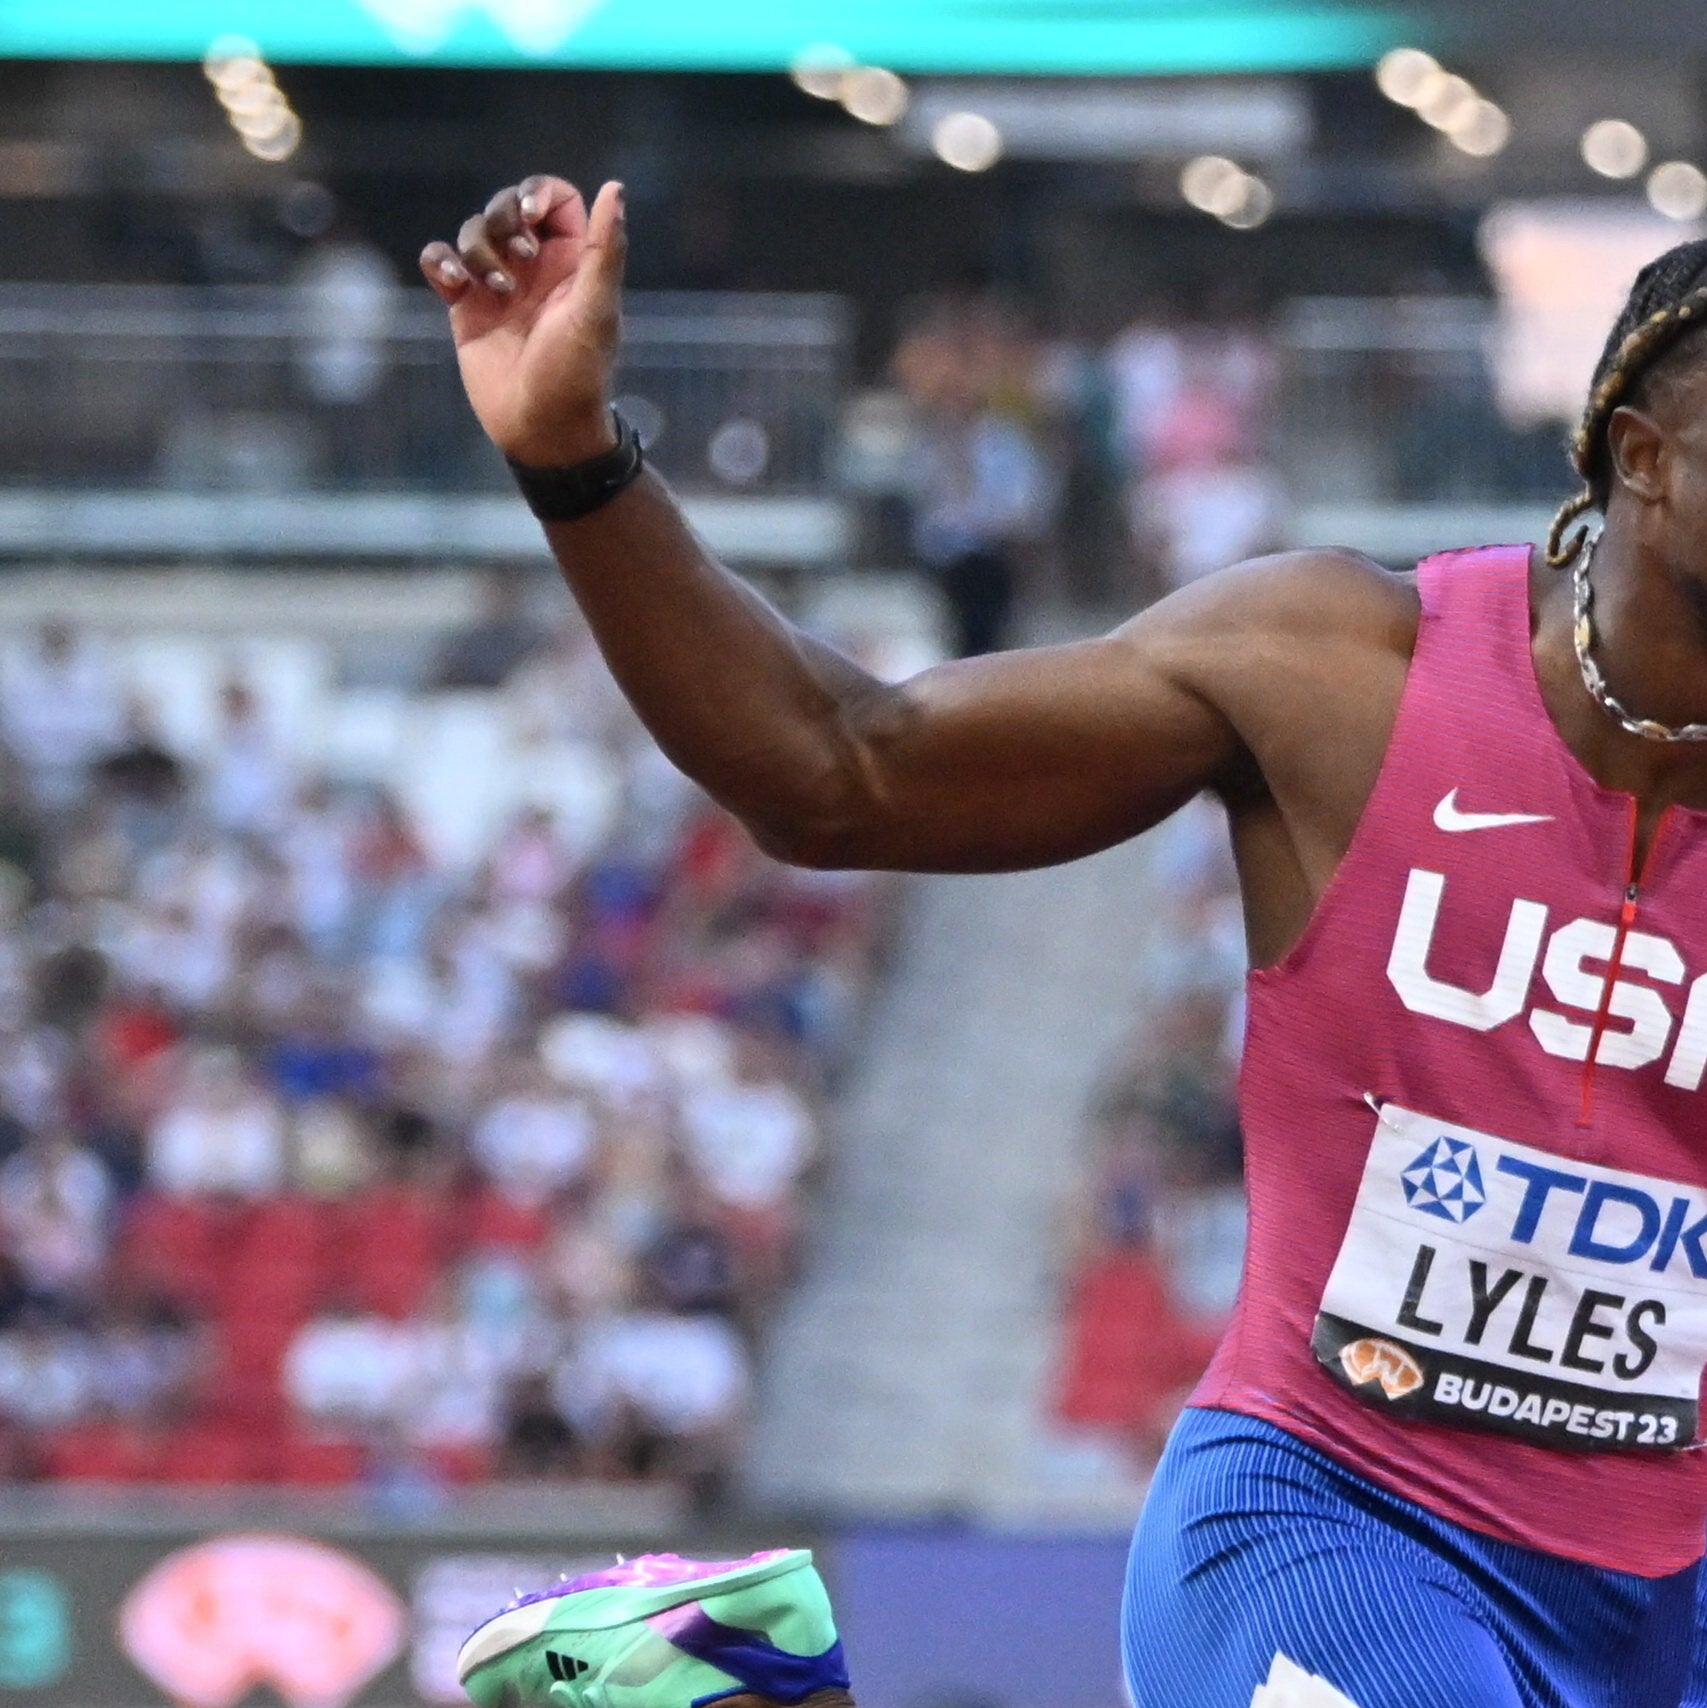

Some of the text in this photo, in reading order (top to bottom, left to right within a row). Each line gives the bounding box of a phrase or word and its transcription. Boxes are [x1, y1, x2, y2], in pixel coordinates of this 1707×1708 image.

[1396, 1244, 1666, 1381] LYLES
[1433, 1372, 1679, 1444] BUDAPEST 23
